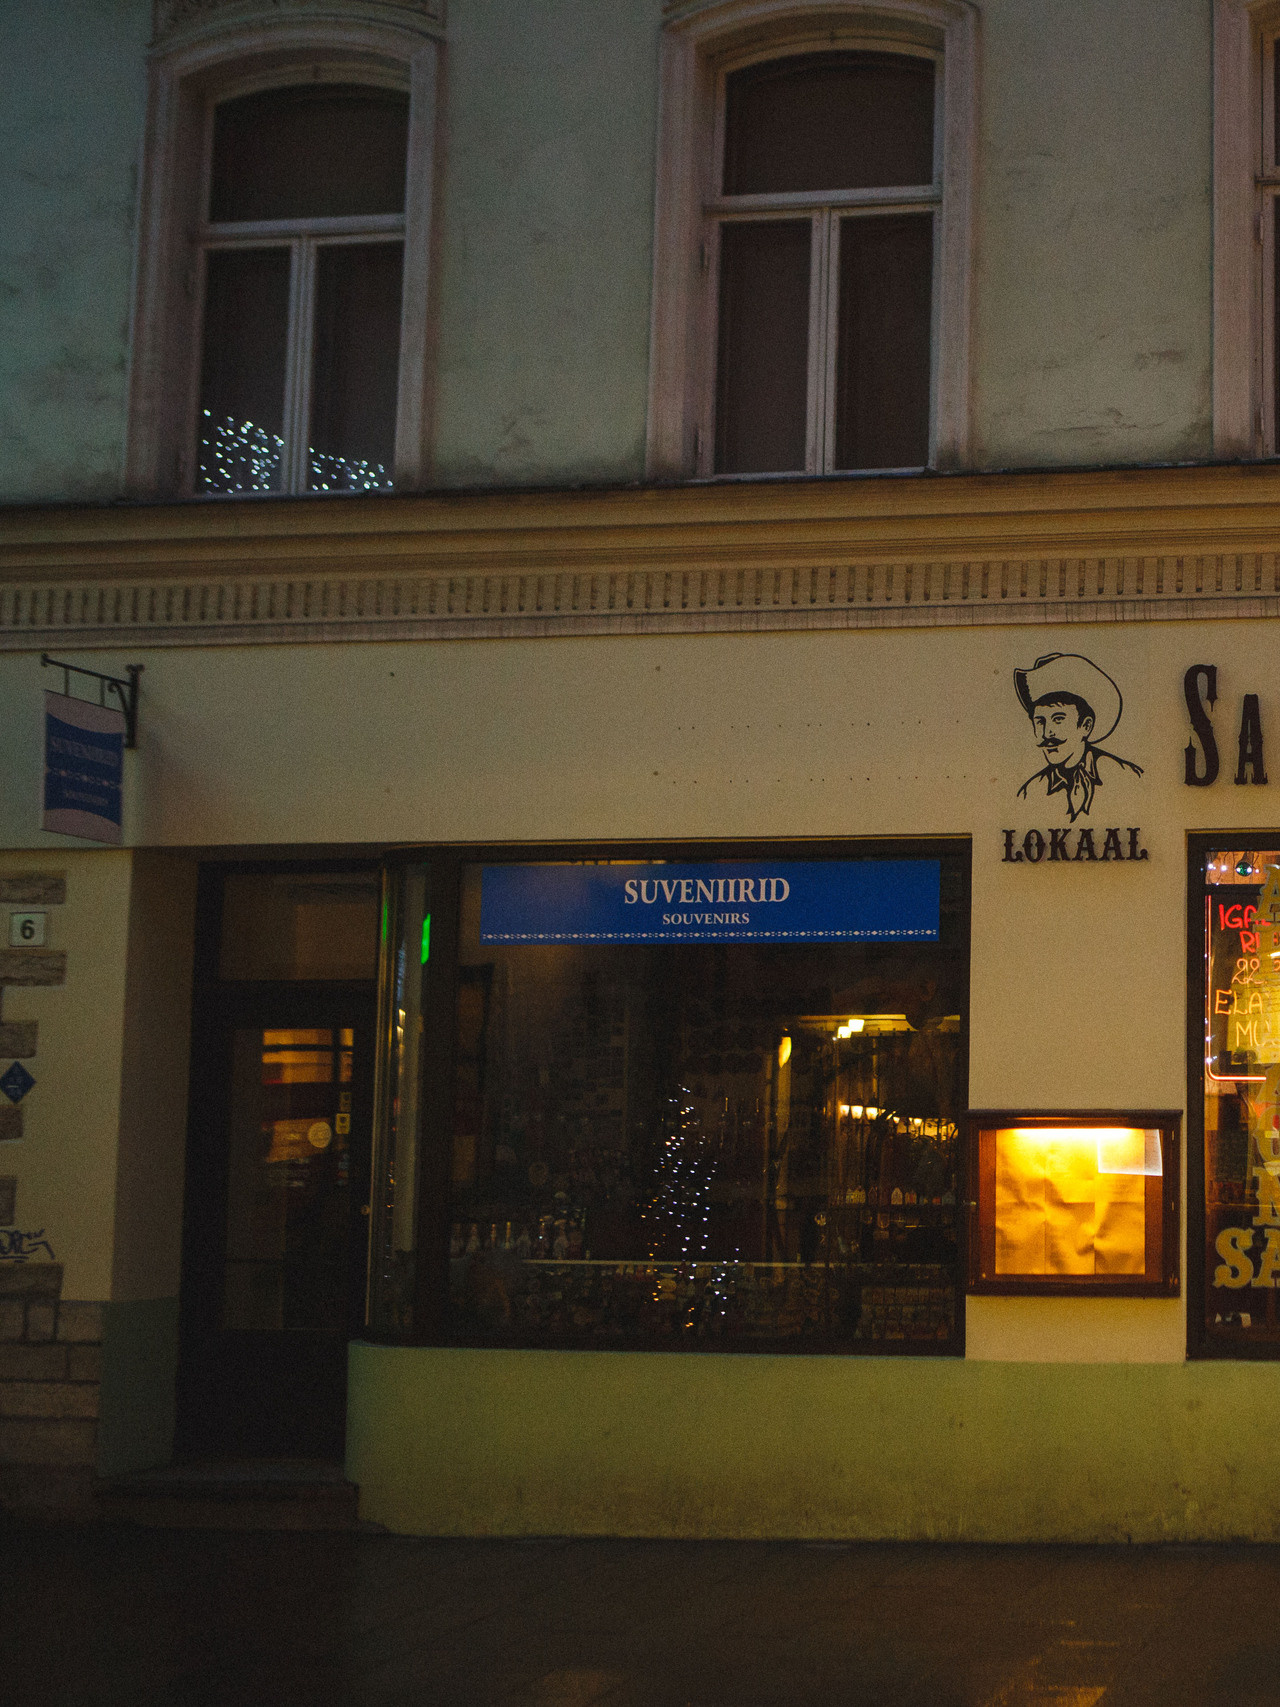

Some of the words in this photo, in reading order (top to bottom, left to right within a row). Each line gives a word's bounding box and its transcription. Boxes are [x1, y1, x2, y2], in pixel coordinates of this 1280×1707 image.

[1001, 827, 1150, 863] LOKAAL
[623, 877, 791, 905] SUVENIIRID
[20, 918, 35, 940] 6
[661, 911, 751, 926] SOUVENIRS
